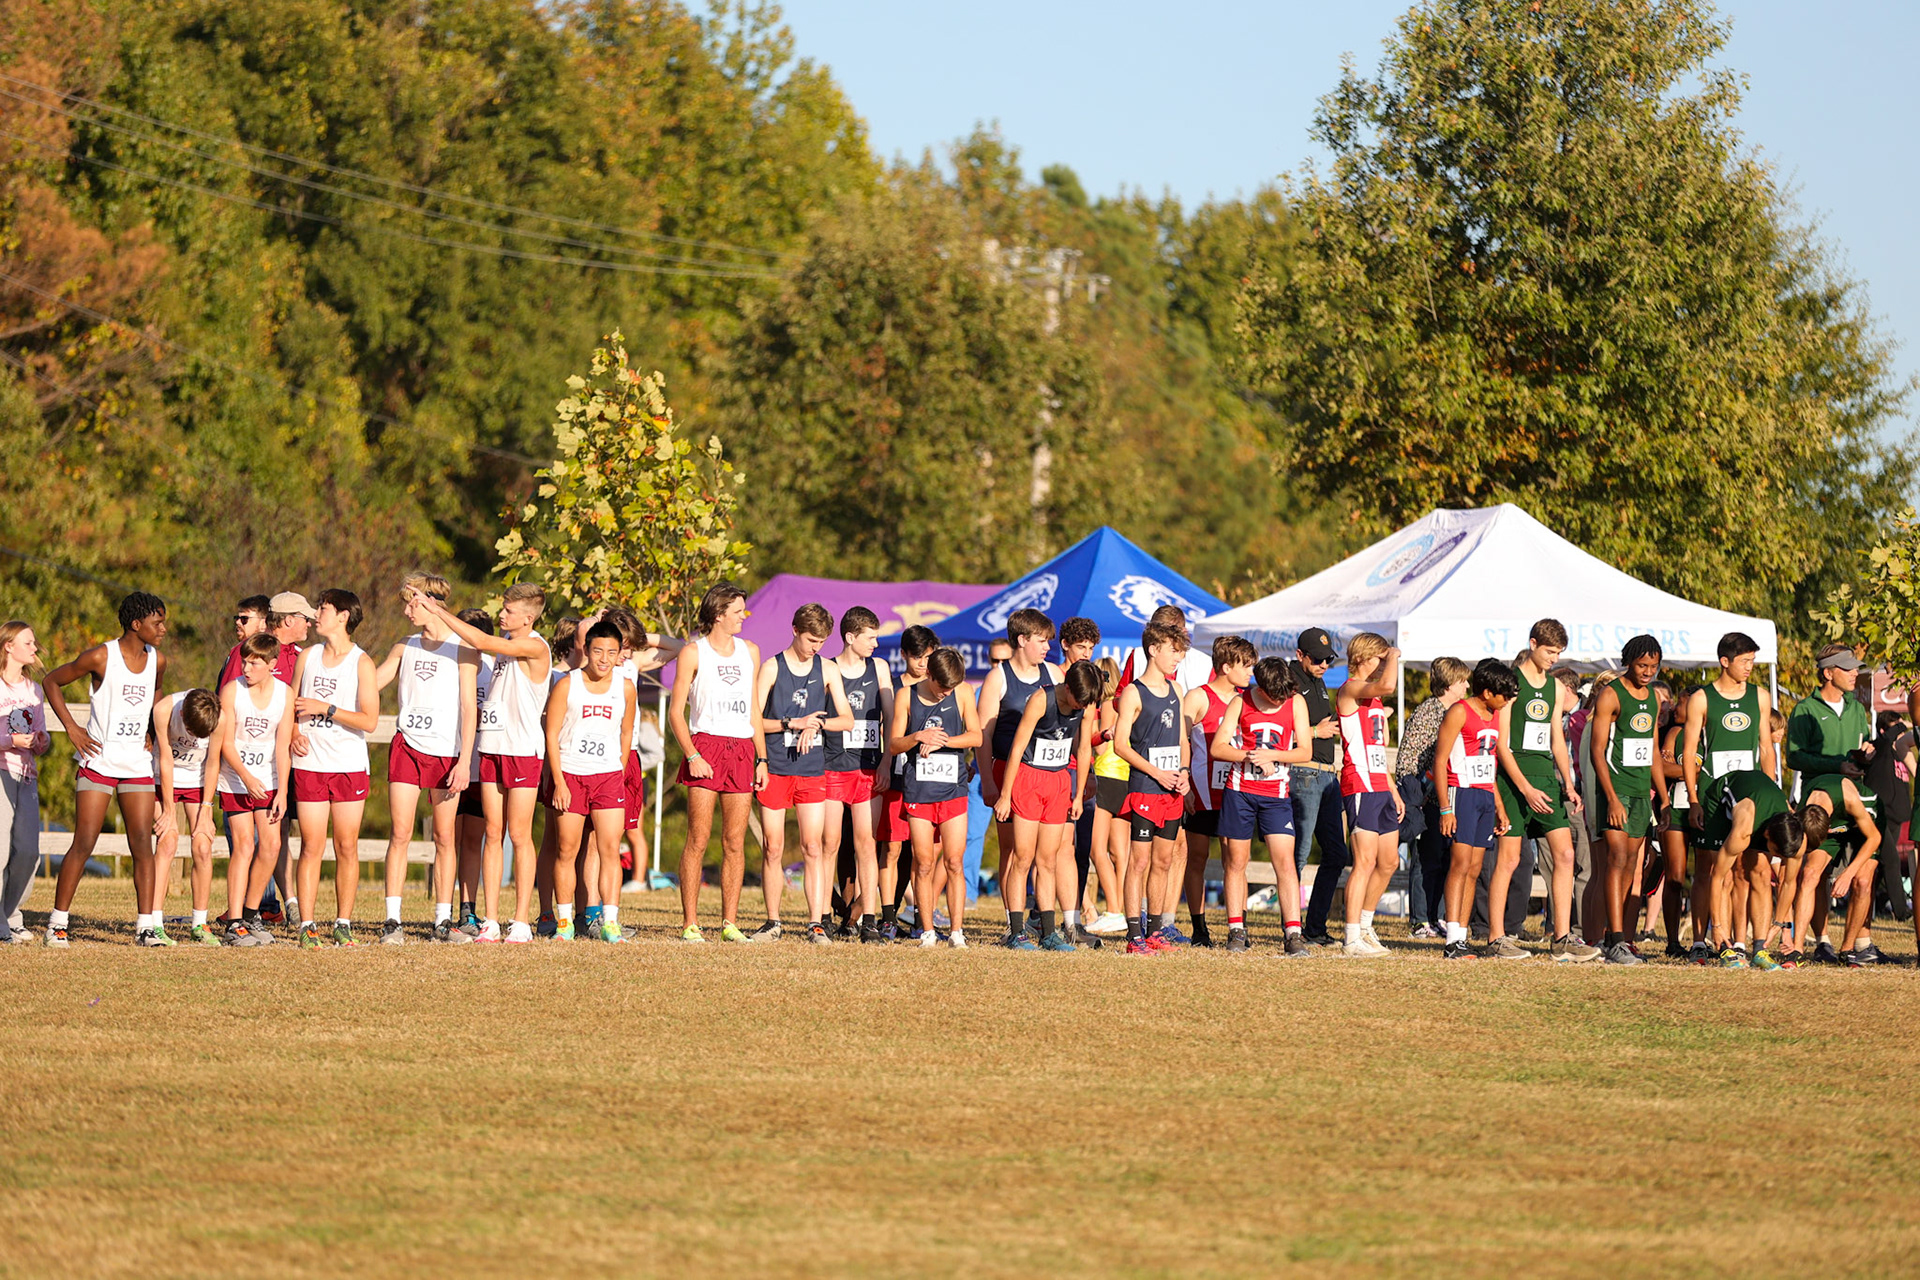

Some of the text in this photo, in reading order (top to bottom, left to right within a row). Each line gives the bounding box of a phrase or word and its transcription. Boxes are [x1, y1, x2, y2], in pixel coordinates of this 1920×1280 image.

[1614, 625, 1691, 655] STRS
[414, 660, 438, 672] ECS
[717, 665, 741, 676] ECS
[313, 676, 337, 690] ECS
[122, 684, 146, 698] ECS
[582, 704, 612, 720] ECS
[245, 716, 269, 729] ECS
[309, 714, 333, 728] 326
[406, 714, 433, 729] 329
[116, 722, 141, 736] 332
[848, 729, 876, 743] 1338
[1536, 732, 1547, 745] 61
[579, 740, 605, 757] 328
[1041, 747, 1067, 761] 1341
[1635, 747, 1648, 761] 62
[240, 750, 264, 766] 330
[921, 762, 953, 777] 1342
[1471, 763, 1493, 778] 1547
